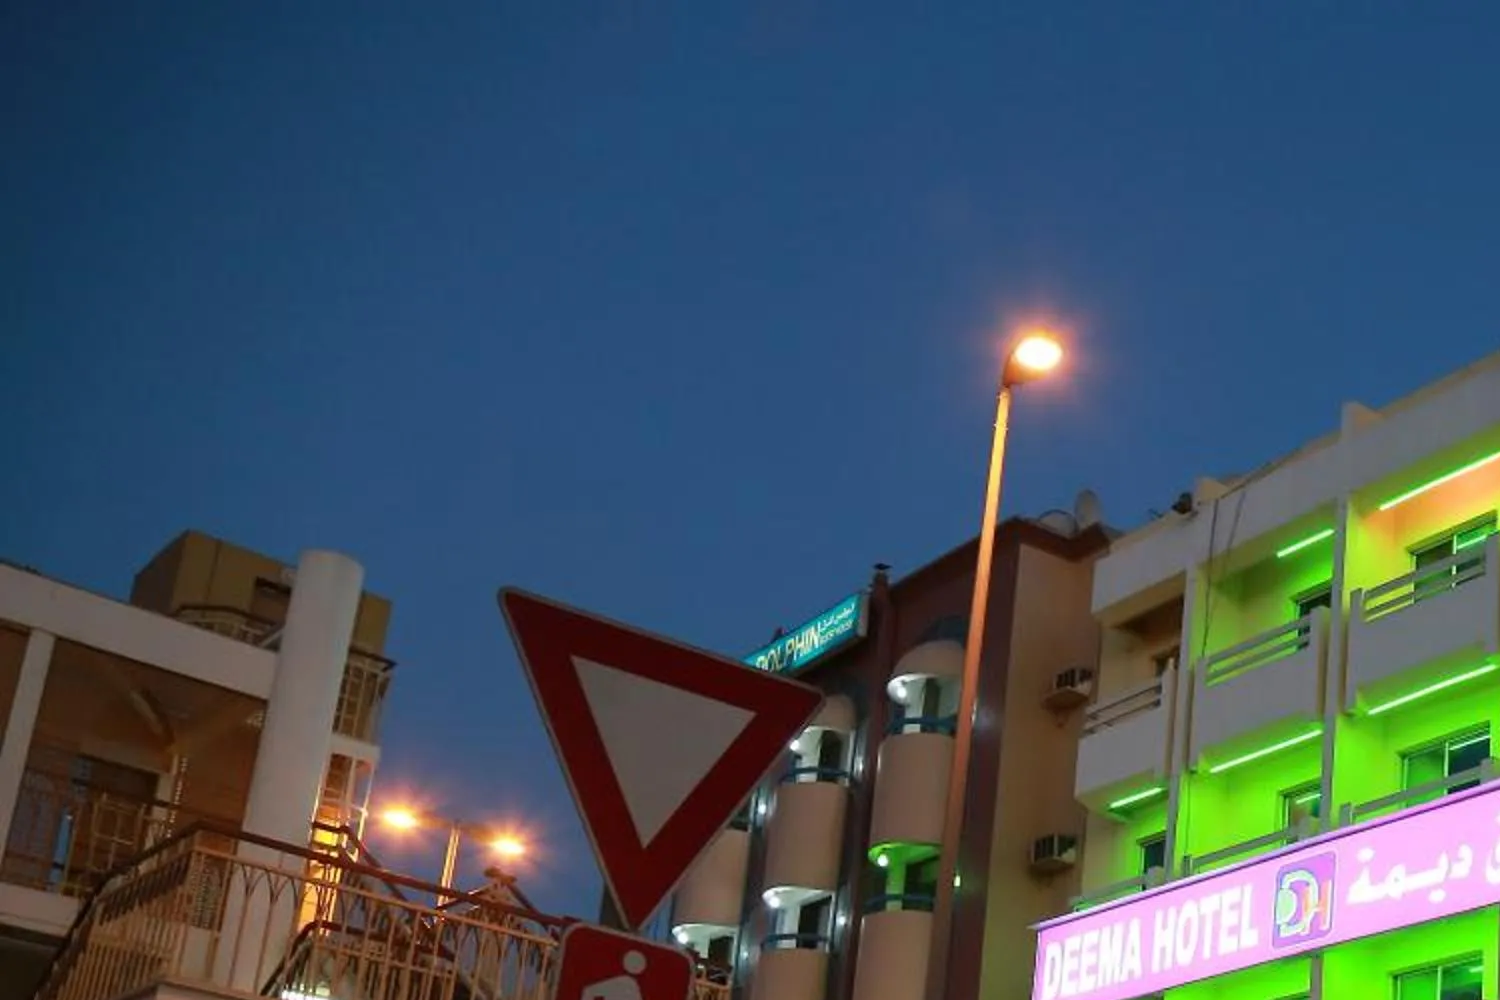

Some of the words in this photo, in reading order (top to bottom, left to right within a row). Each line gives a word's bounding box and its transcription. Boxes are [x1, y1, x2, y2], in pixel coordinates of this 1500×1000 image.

[1348, 847, 1473, 904] ديمة
[1042, 925, 1142, 1000] DEEMA
[1151, 883, 1258, 973] HOTEL
